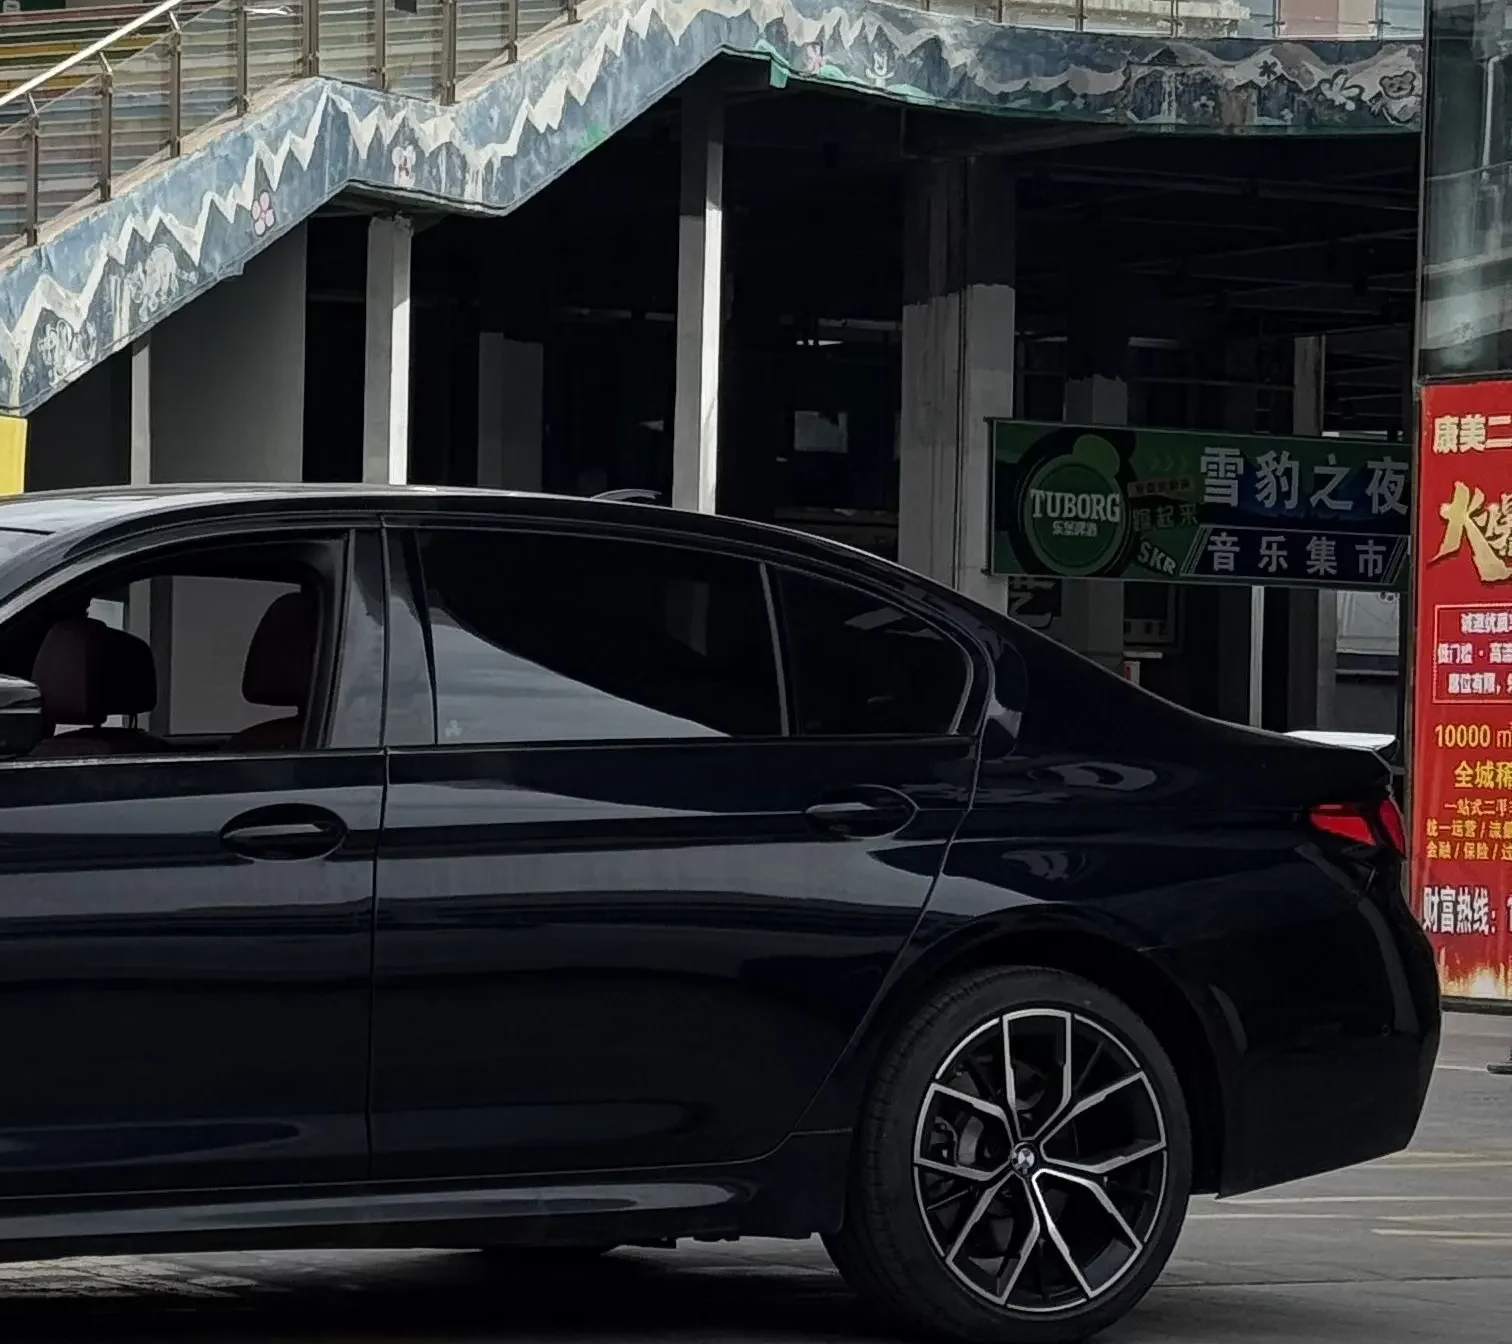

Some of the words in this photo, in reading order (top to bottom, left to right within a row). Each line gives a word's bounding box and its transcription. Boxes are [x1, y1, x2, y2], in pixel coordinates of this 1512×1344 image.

[1200, 446, 1409, 516] 雪豹之夜
[1029, 489, 1121, 522] TUBORG
[1137, 541, 1178, 575] SKR
[1207, 531, 1387, 578] 音乐集市
[1435, 724, 1491, 748] 10000
